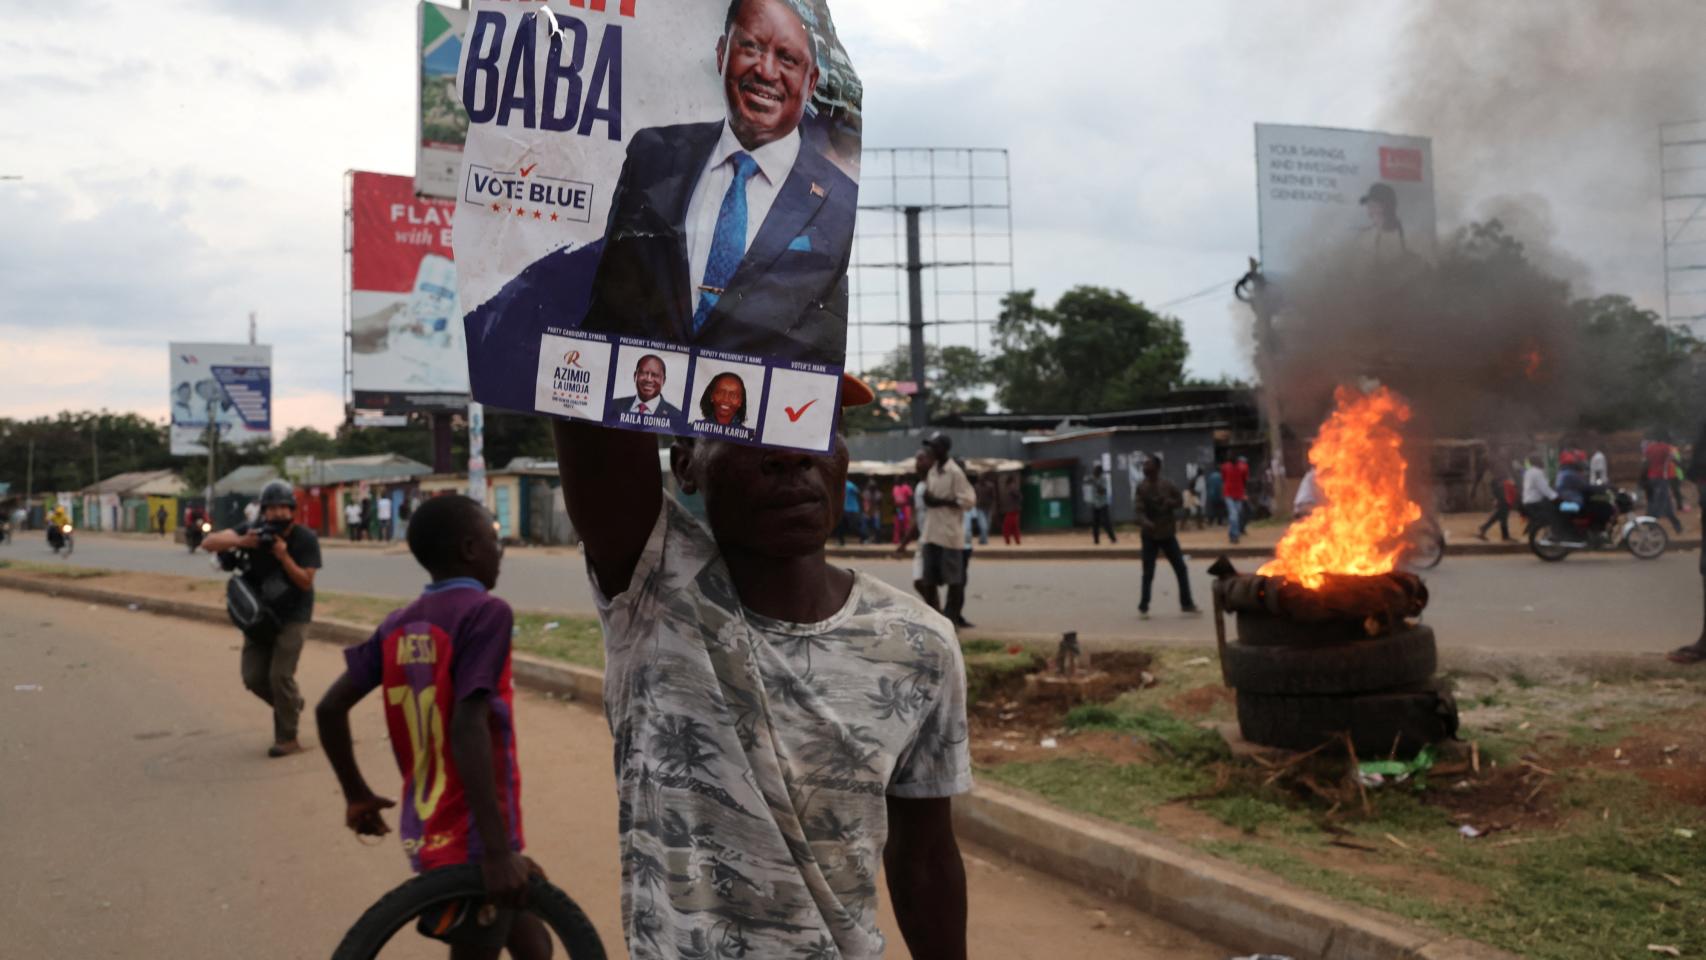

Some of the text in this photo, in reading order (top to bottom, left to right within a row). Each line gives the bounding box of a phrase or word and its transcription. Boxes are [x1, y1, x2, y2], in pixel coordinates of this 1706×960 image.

[463, 10, 623, 142] BABA
[474, 173, 586, 209] VOTE BLUE
[547, 326, 607, 341] PARTY CANDIDATE SYMBOL
[651, 341, 666, 349] PHOTO
[677, 344, 690, 352] NAME
[700, 349, 718, 359] DEPUTY
[553, 366, 591, 384] AZIMIO
[812, 364, 827, 373] MARK
[620, 412, 671, 428] RAILA ODINGA
[693, 422, 749, 440] MARTHA KARUA
[388, 686, 446, 821] 10
